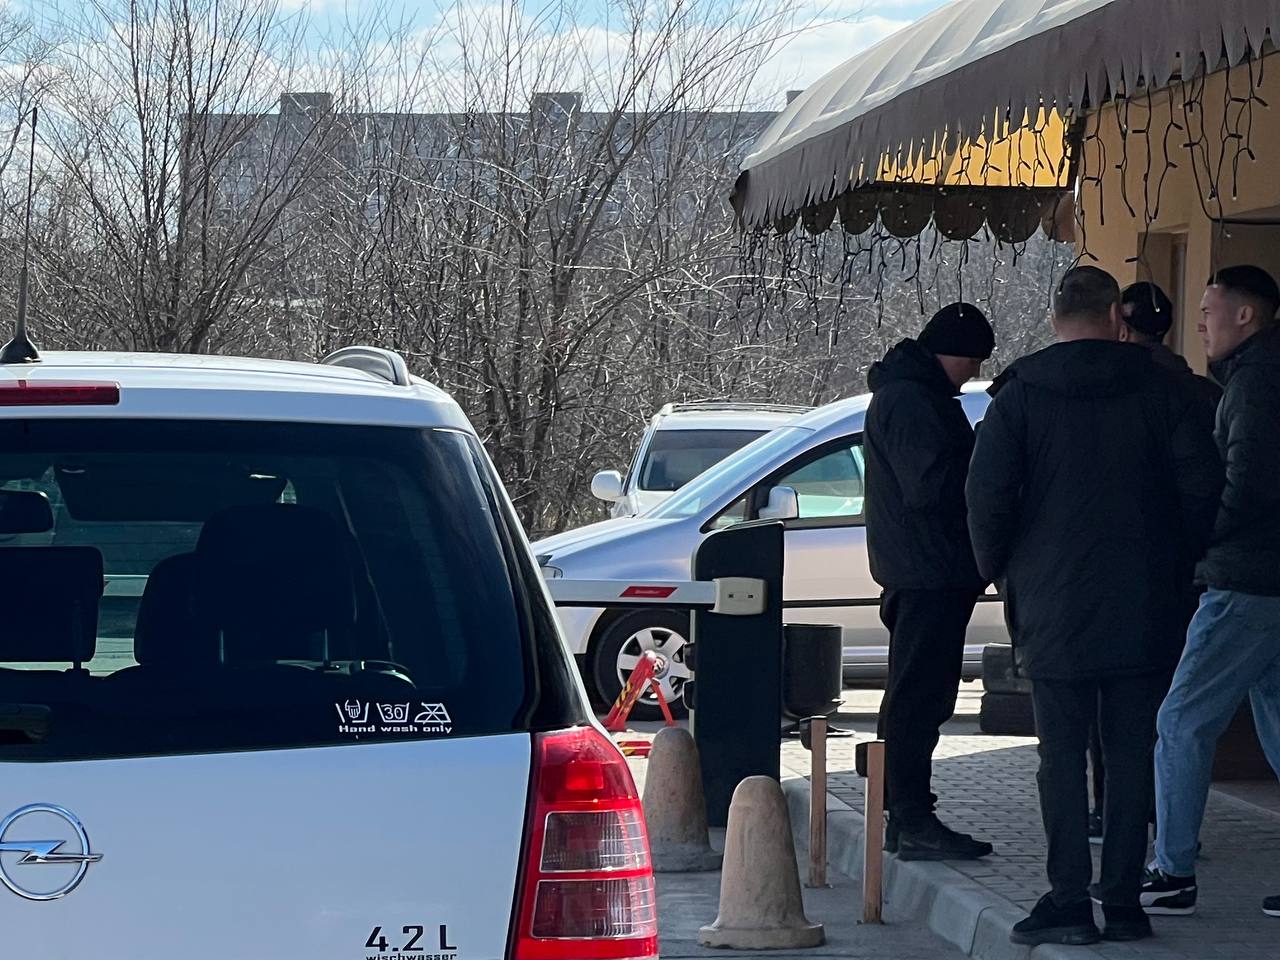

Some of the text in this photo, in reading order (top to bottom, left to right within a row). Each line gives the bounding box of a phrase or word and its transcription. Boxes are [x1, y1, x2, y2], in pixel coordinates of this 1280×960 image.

[381, 724, 417, 732] wash
[422, 724, 452, 734] only
[365, 924, 458, 952] 4.2 L
